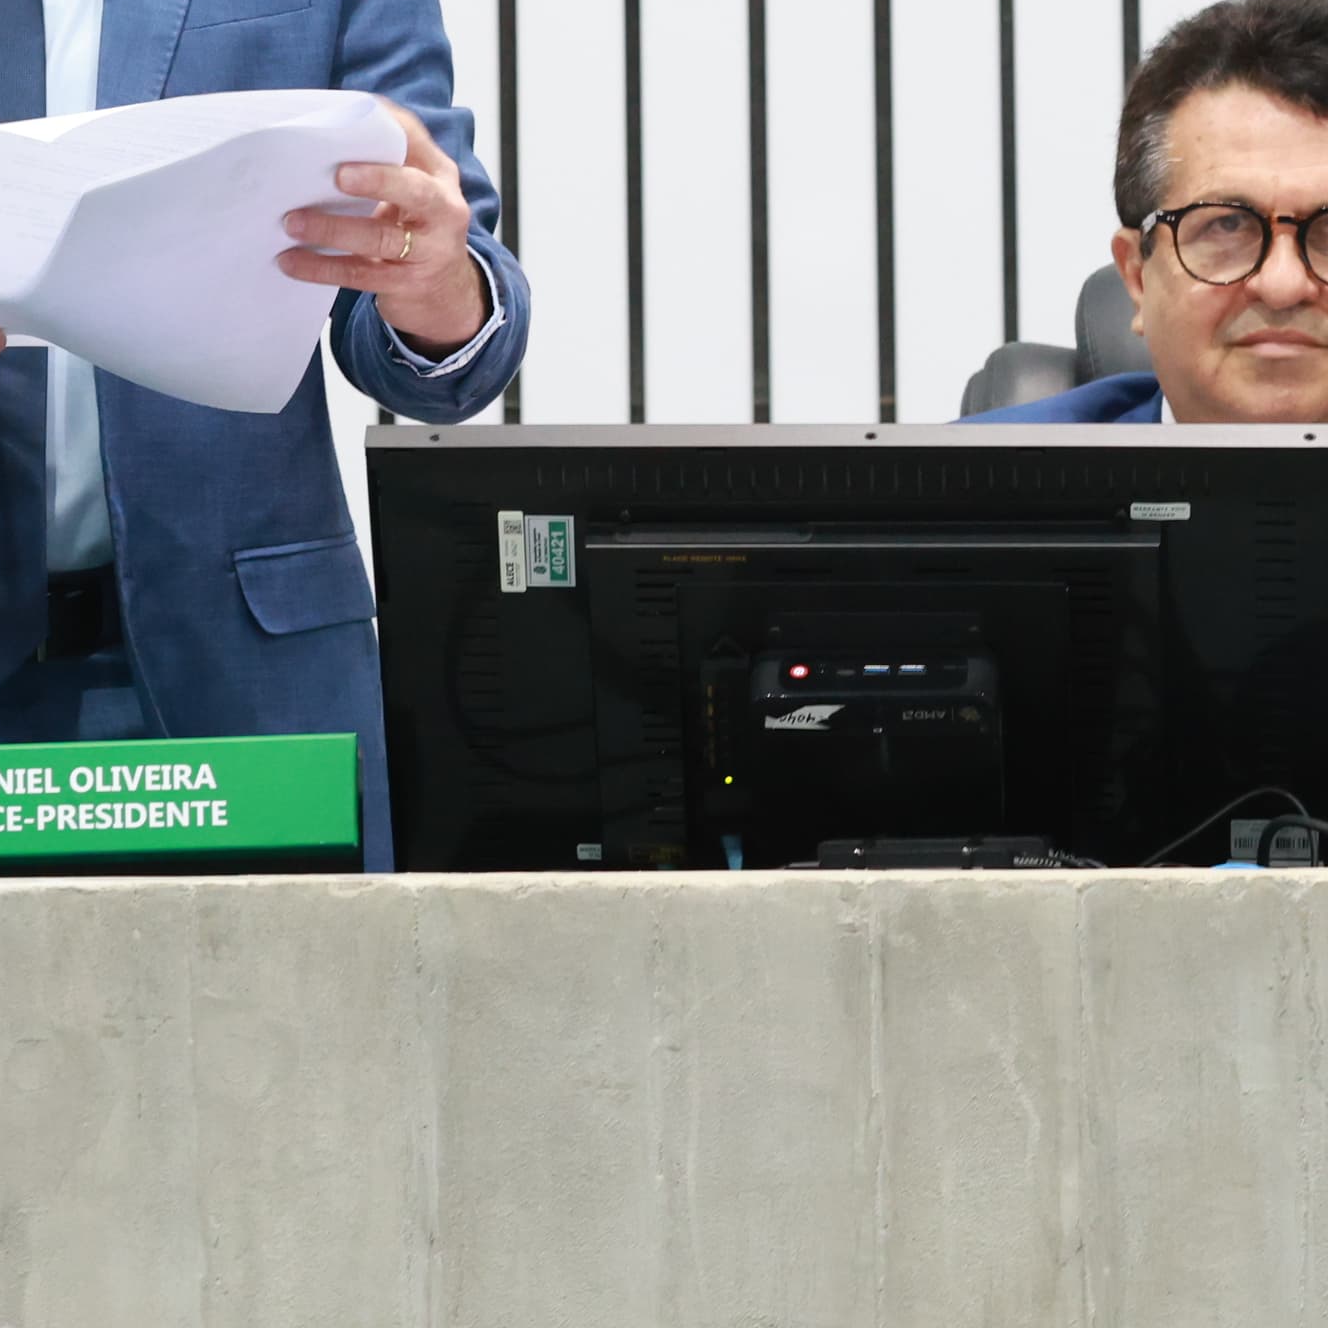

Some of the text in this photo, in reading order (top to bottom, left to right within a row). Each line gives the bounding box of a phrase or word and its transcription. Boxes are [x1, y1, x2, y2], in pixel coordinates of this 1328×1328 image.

[551, 530, 565, 576] 40421
[505, 561, 515, 587] ALECE
[913, 710, 946, 721] AMD
[69, 763, 218, 794] OLIVEIRA
